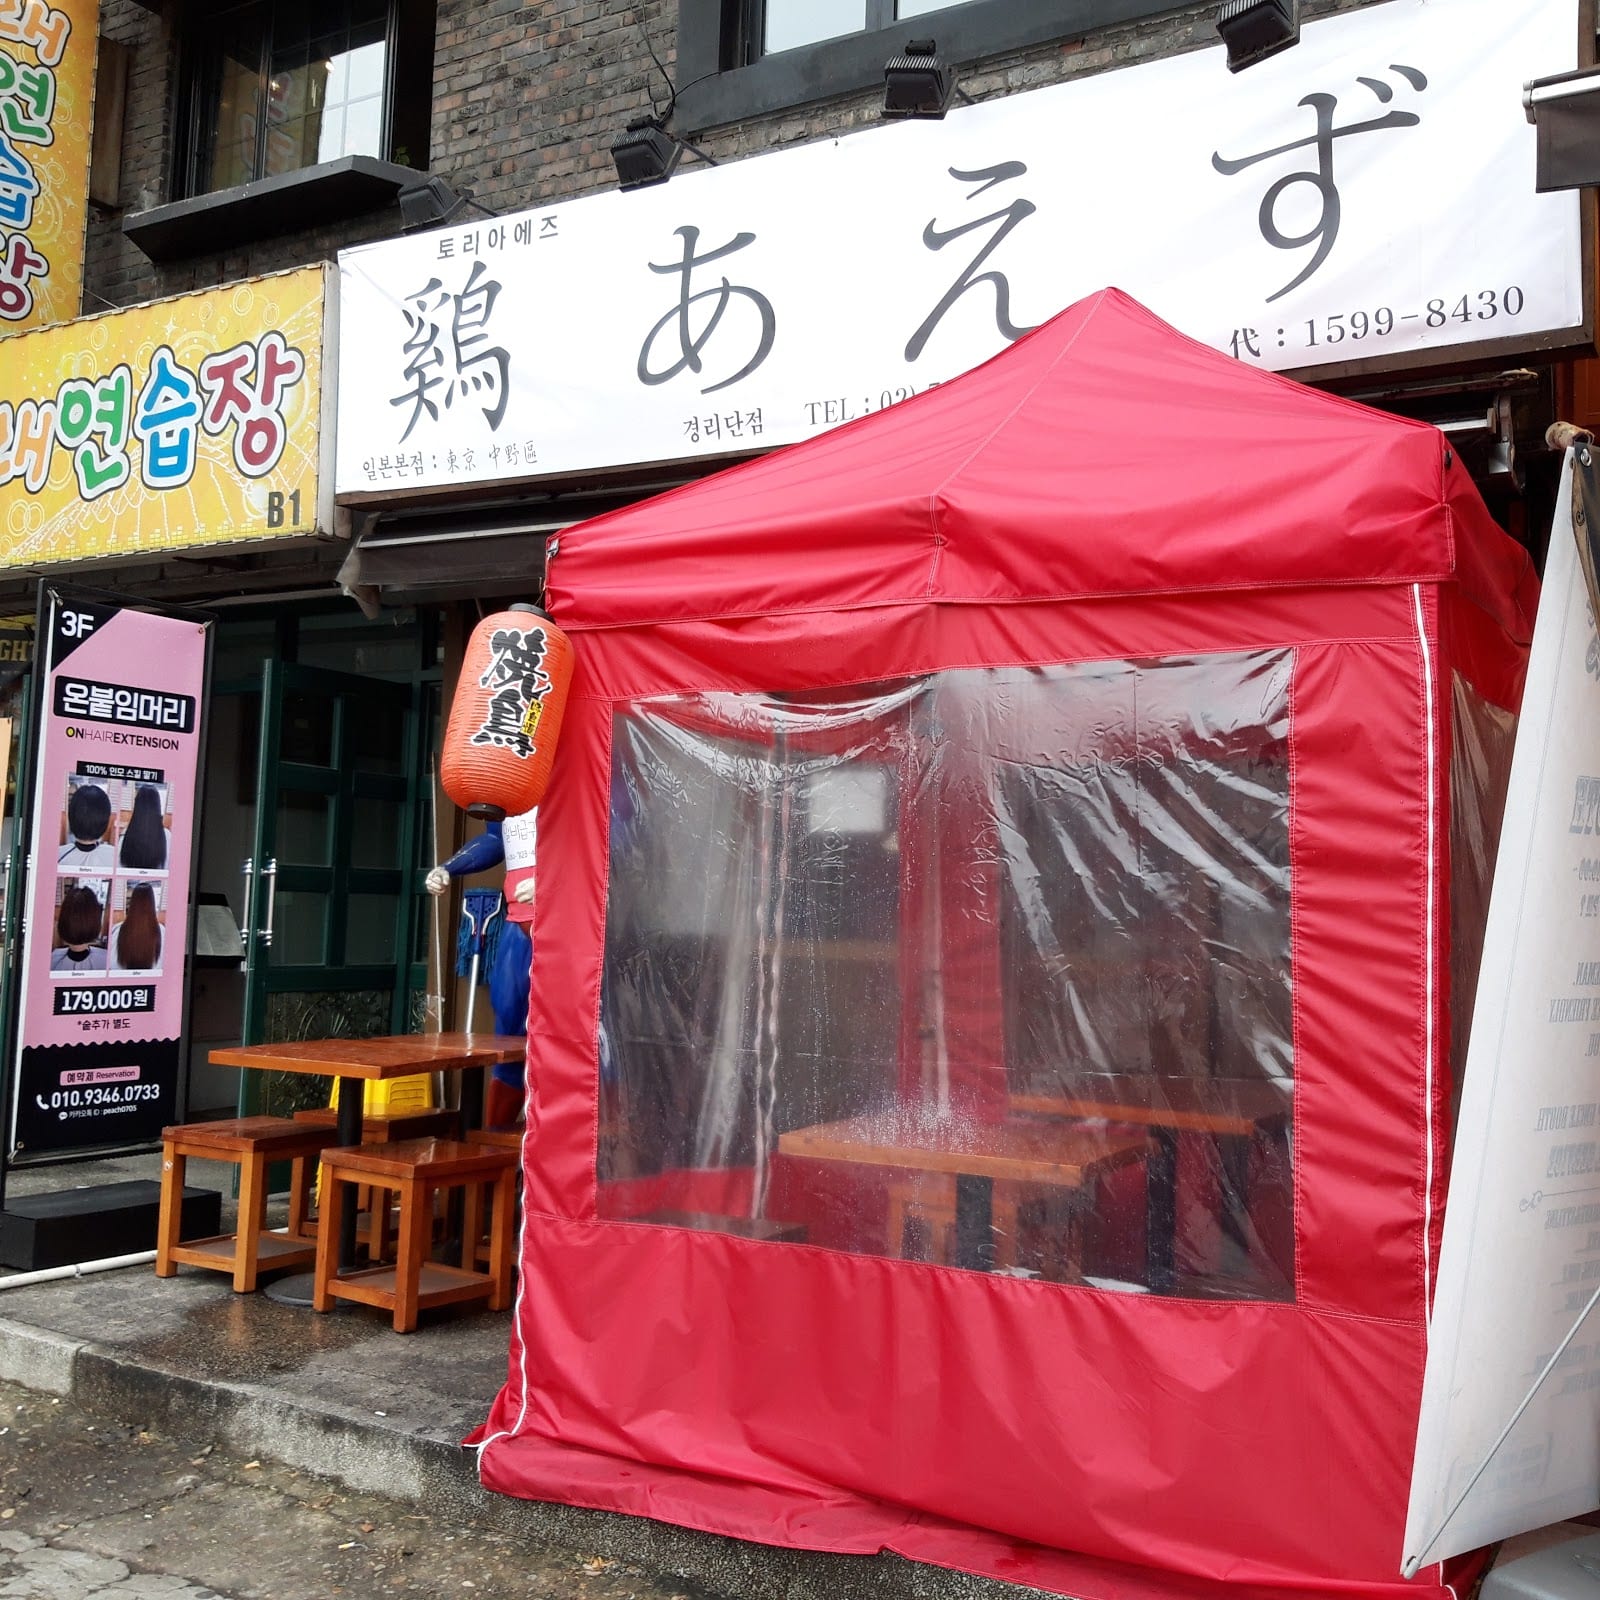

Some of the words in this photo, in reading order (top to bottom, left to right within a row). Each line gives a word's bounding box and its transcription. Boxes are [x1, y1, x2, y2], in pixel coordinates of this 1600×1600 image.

[436, 214, 560, 261] 토리아에즈
[1304, 285, 1525, 348] 1599-8430
[682, 407, 765, 443] 경리단점
[362, 451, 425, 482] 일본본점
[266, 487, 301, 530] B1
[60, 610, 95, 639] 3F
[62, 681, 188, 729] 온붙임머리
[85, 764, 108, 776] 100%
[61, 988, 149, 1013] 179,000원
[67, 1071, 94, 1084] 예약제
[95, 1069, 136, 1080] Reservation
[51, 1083, 161, 1109] 010.9346.0733
